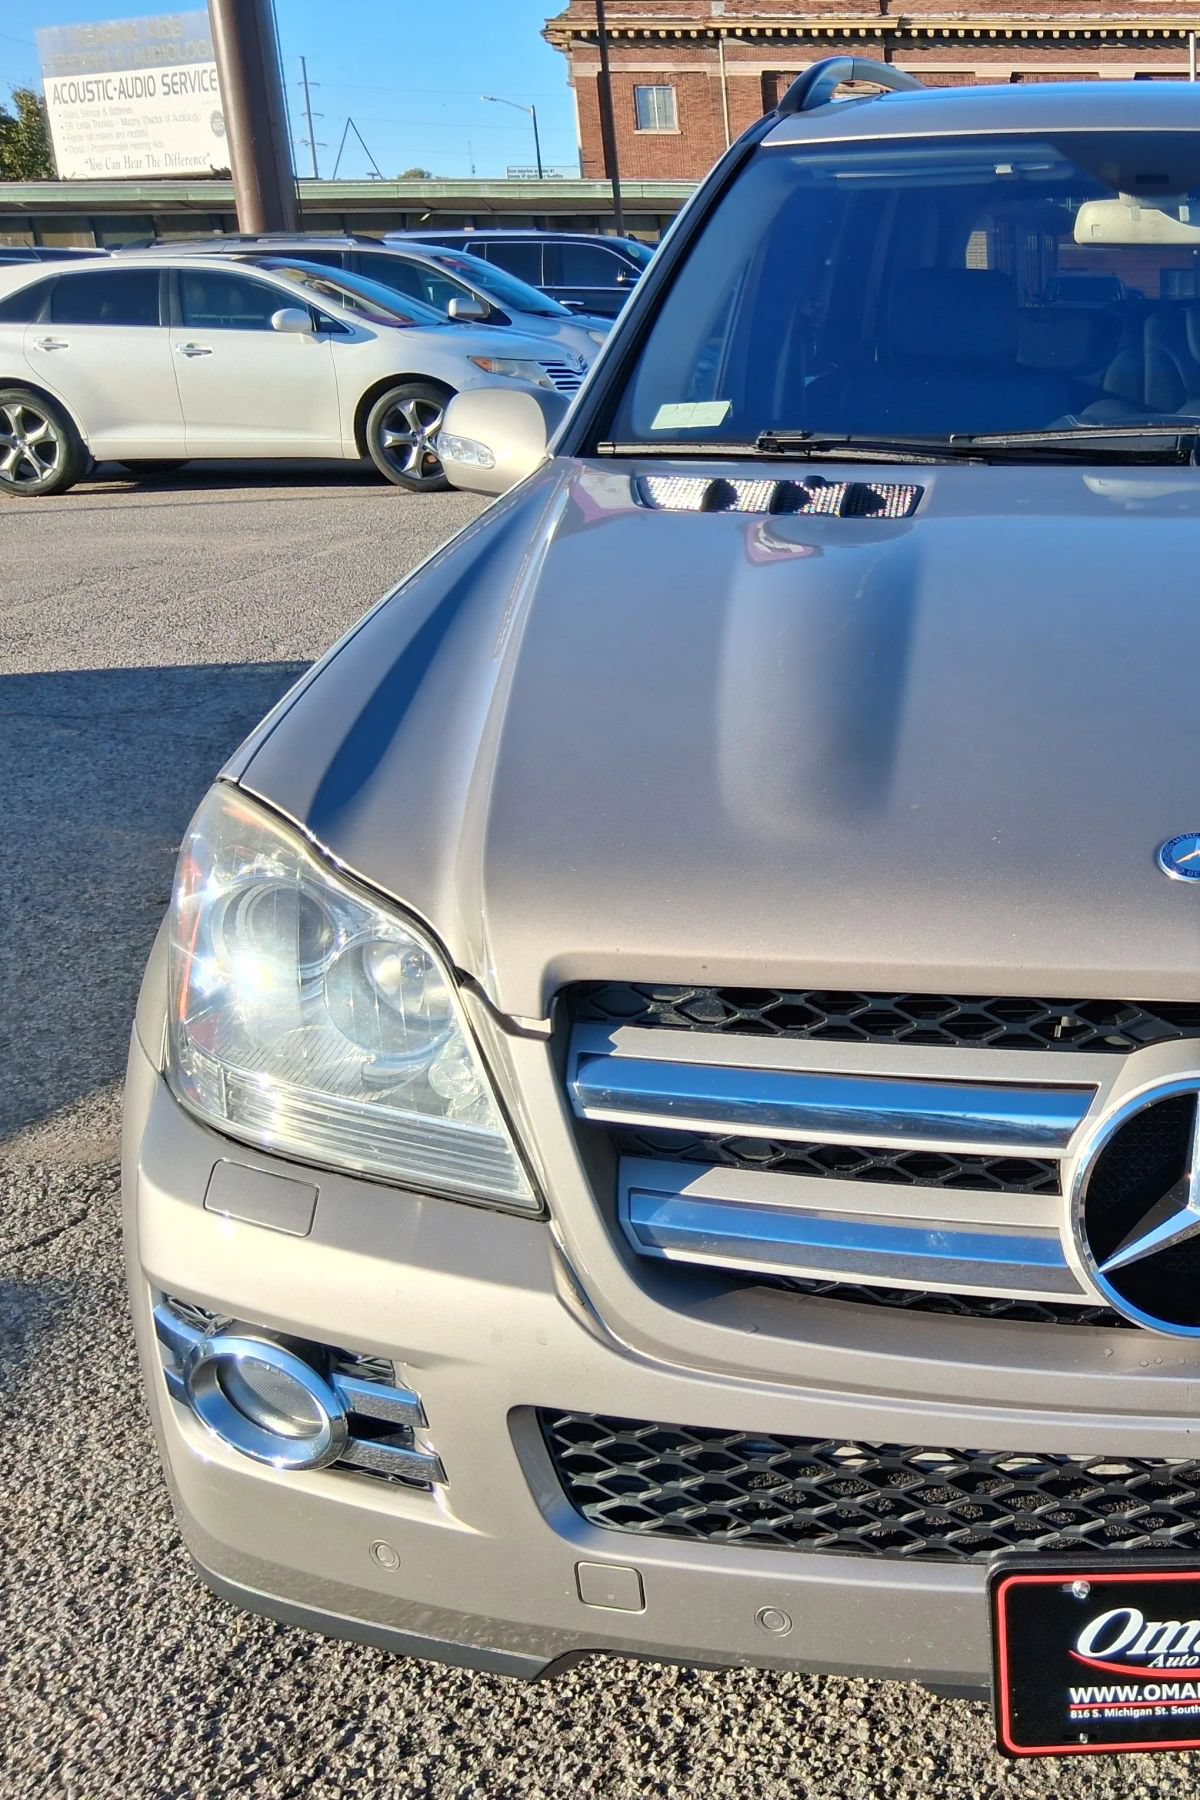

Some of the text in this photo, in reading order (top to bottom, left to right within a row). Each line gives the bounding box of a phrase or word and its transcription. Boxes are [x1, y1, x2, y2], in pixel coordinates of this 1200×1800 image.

[134, 39, 217, 64] AUDIOLOG
[105, 157, 121, 170] Can
[123, 154, 143, 170] Hear
[145, 153, 161, 169] The
[1147, 1654, 1200, 1668] Auto
[1070, 1709, 1090, 1719] 816
[1092, 1708, 1102, 1718] S.
[1104, 1707, 1152, 1718] Michigan
[1155, 1706, 1168, 1715] St.
[1171, 1704, 1200, 1714] South
